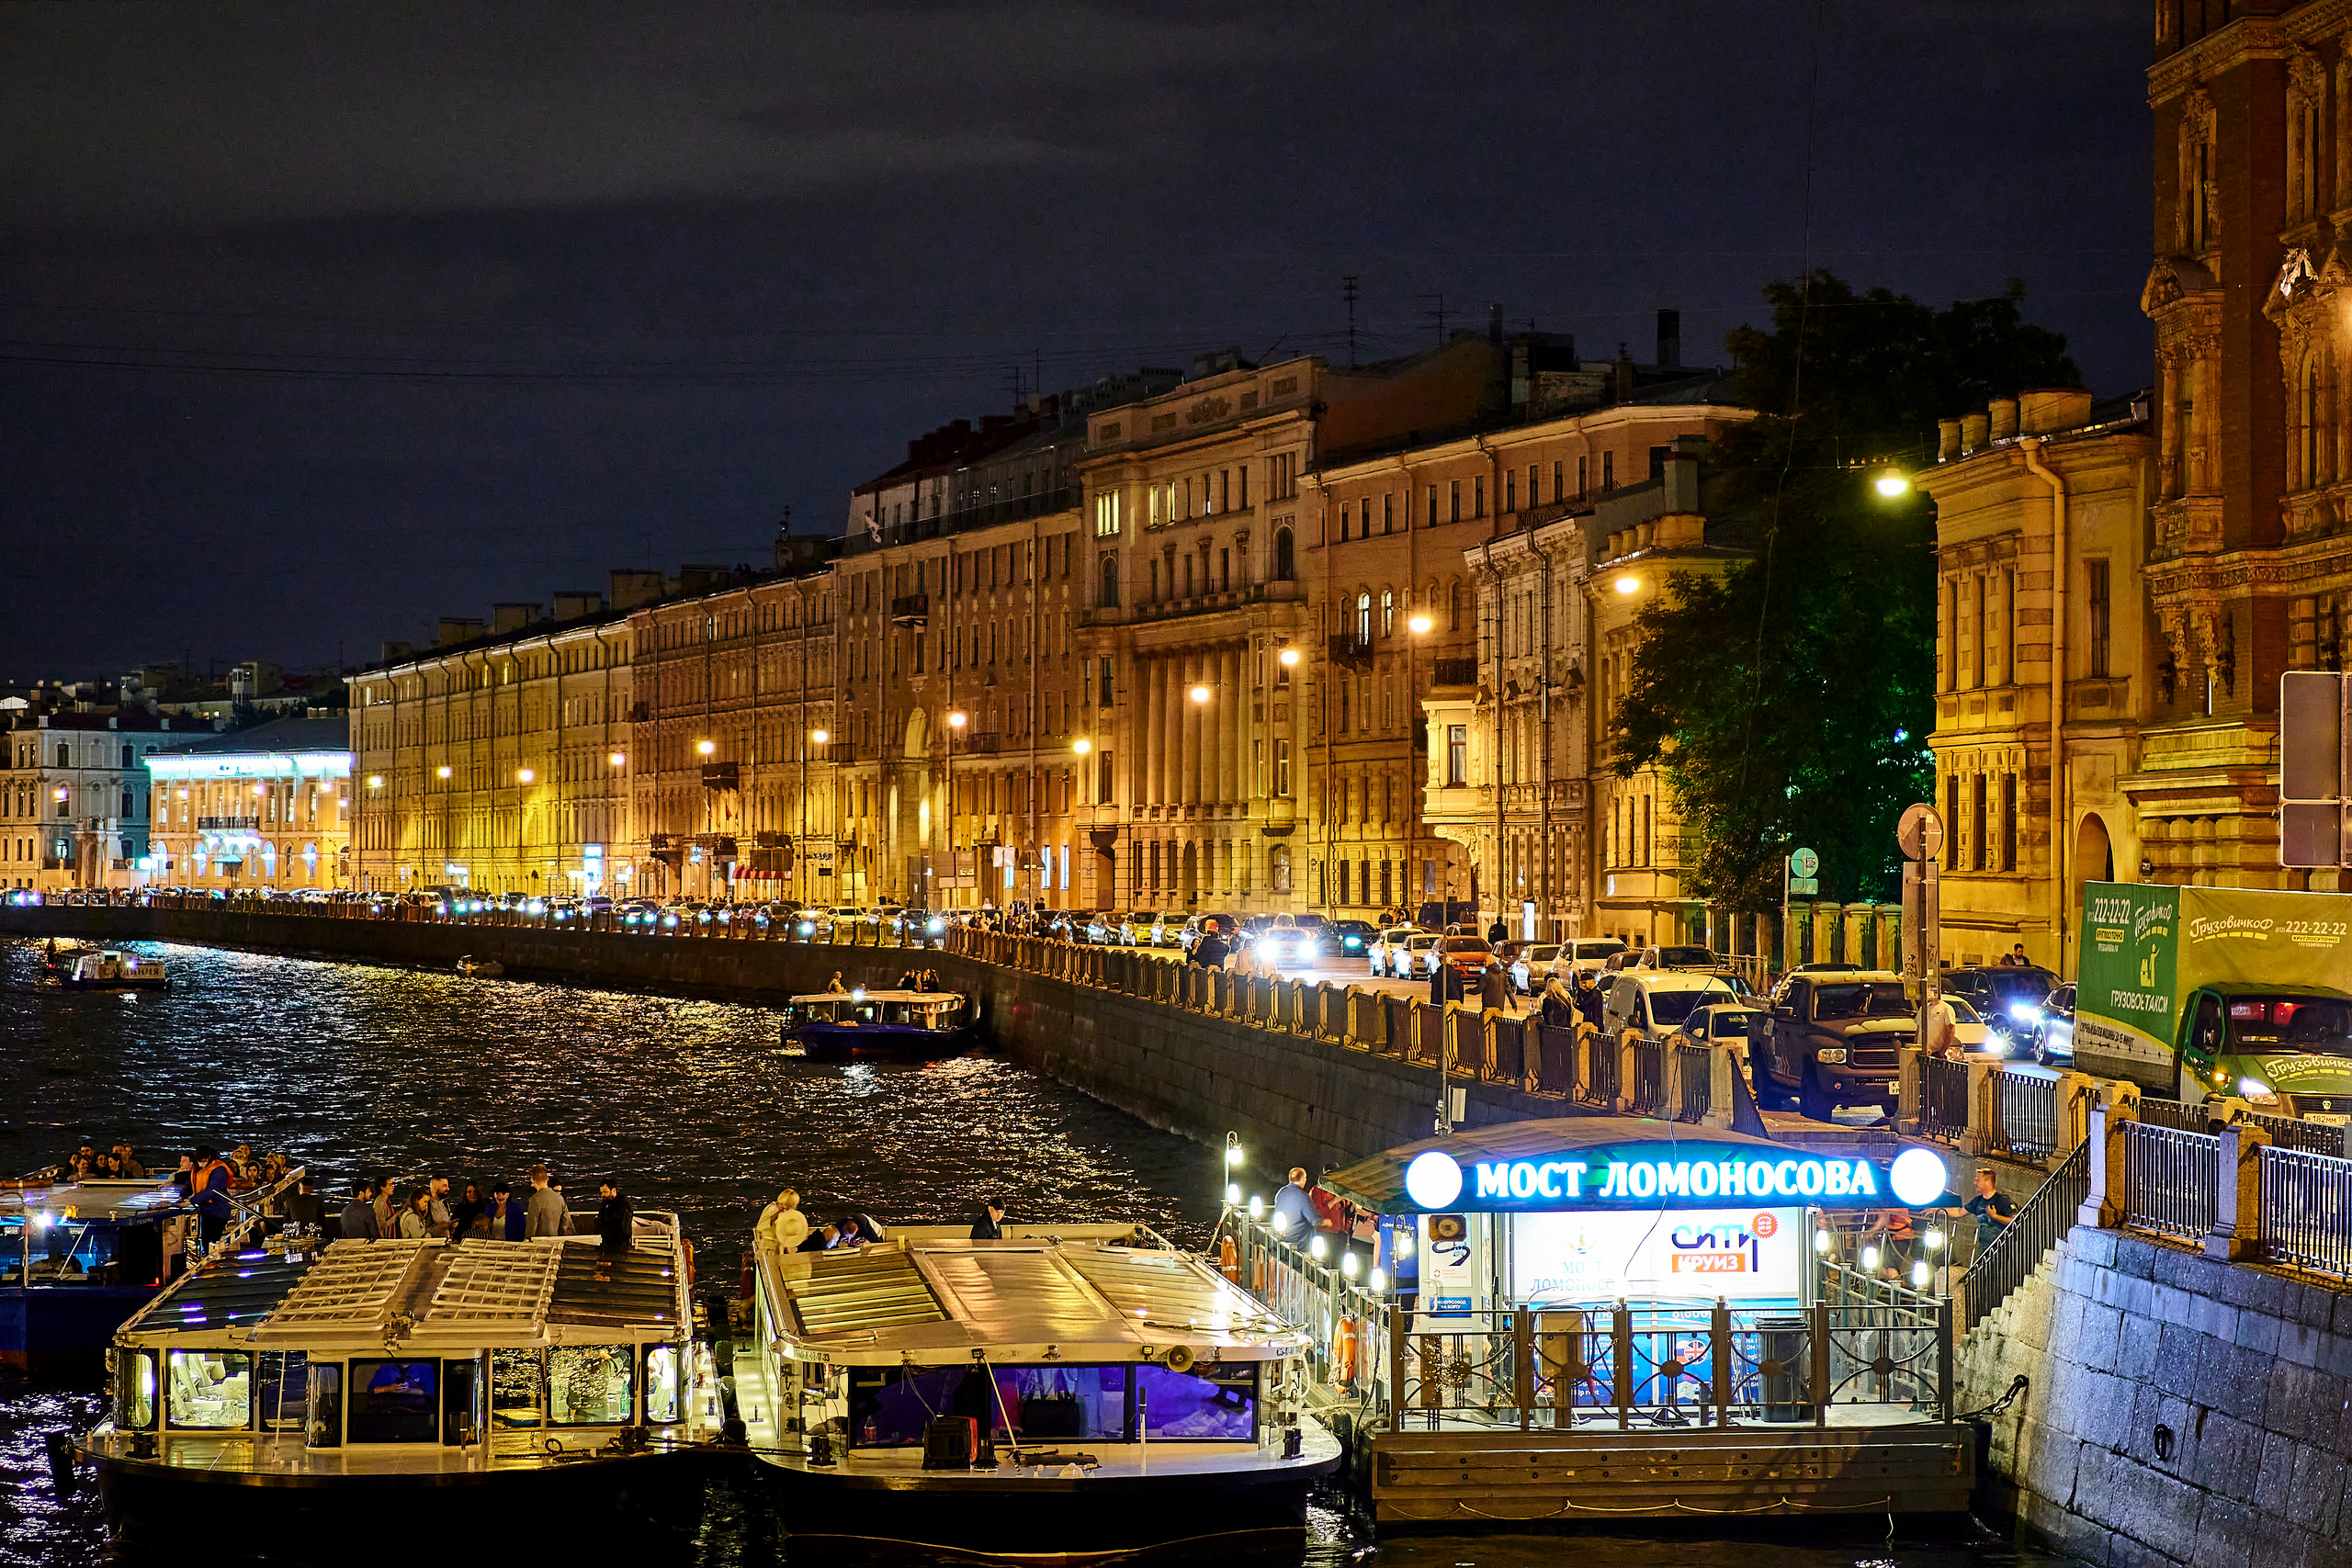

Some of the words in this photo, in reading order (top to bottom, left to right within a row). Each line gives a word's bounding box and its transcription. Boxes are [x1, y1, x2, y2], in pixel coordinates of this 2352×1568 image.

[2286, 920, 2347, 935] 222-22-22
[2110, 989, 2144, 1010] ГРУЗОВОЕ
[2143, 994, 2168, 1013] ТАКСИ
[1476, 1162, 1587, 1196] МОСТ
[1600, 1159, 1877, 1196] ЛОМОНОСОВА
[1562, 1261, 1602, 1274] МОСТ
[1678, 1254, 1739, 1271] КРУИЗ
